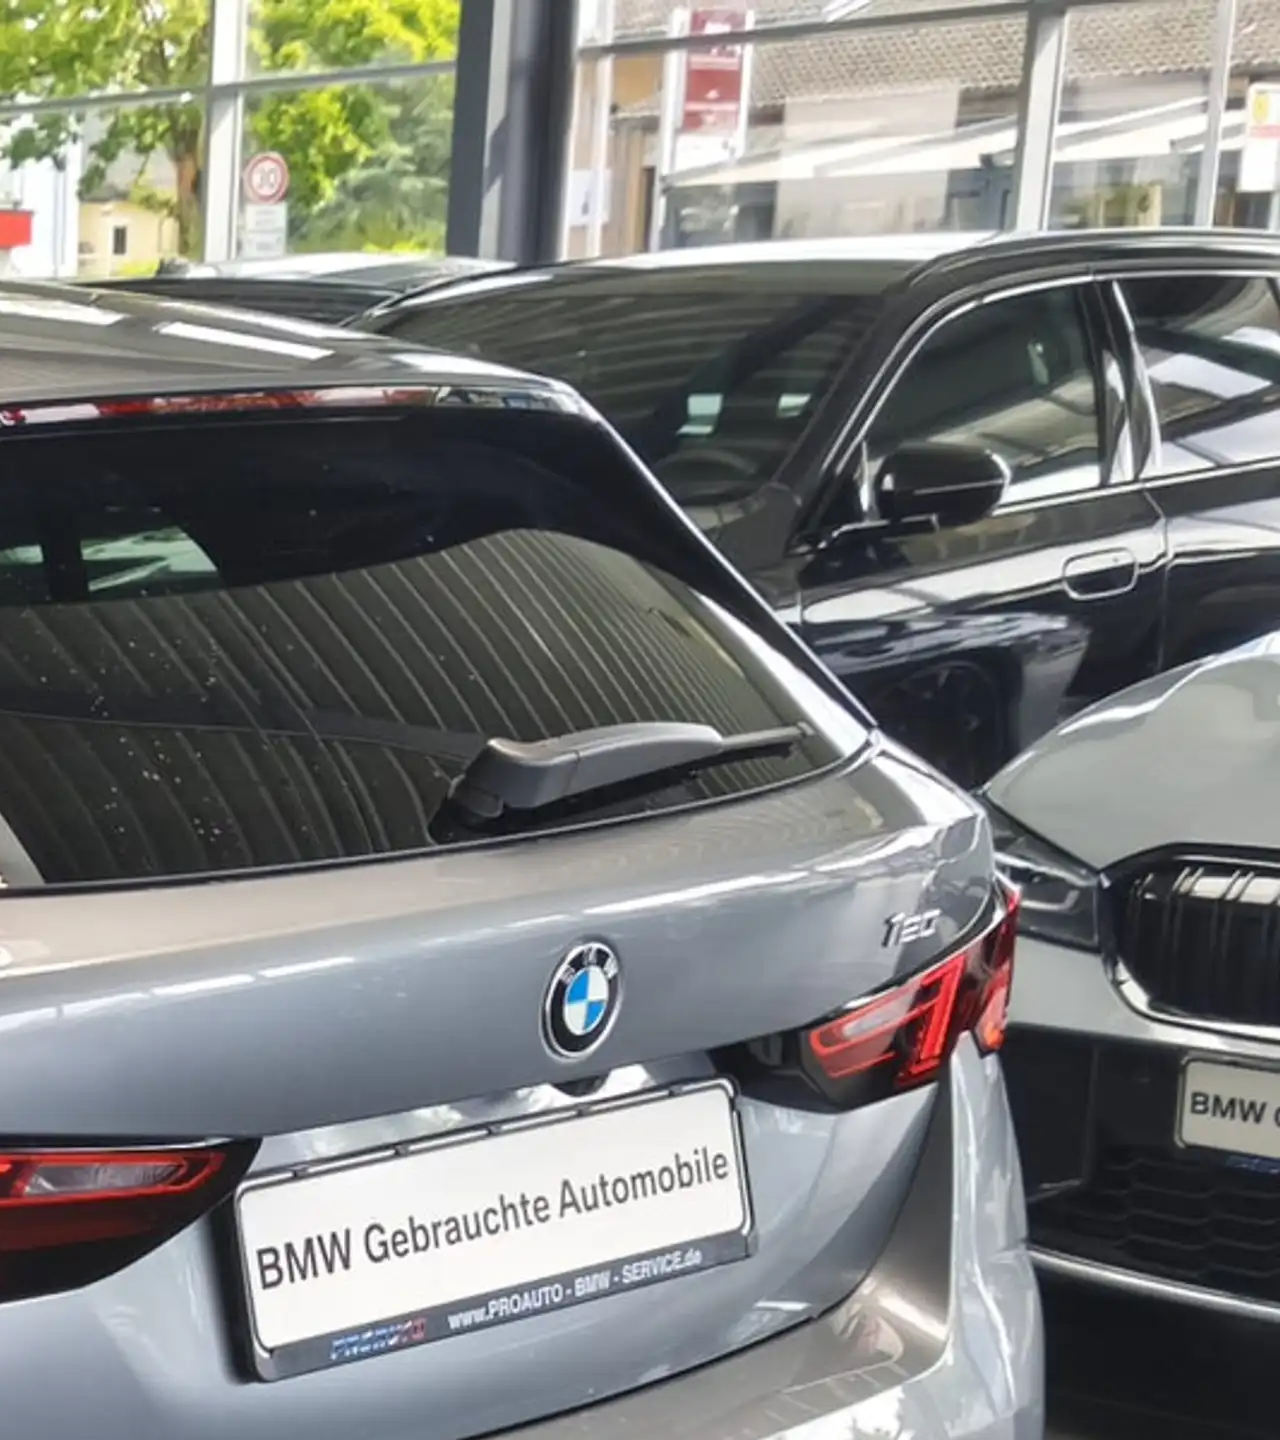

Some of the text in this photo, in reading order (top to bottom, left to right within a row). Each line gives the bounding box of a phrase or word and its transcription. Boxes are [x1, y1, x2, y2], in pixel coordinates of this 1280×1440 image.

[1190, 1091, 1268, 1125] BMW
[256, 1146, 729, 1291] BMW Gebrauchte Automobile
